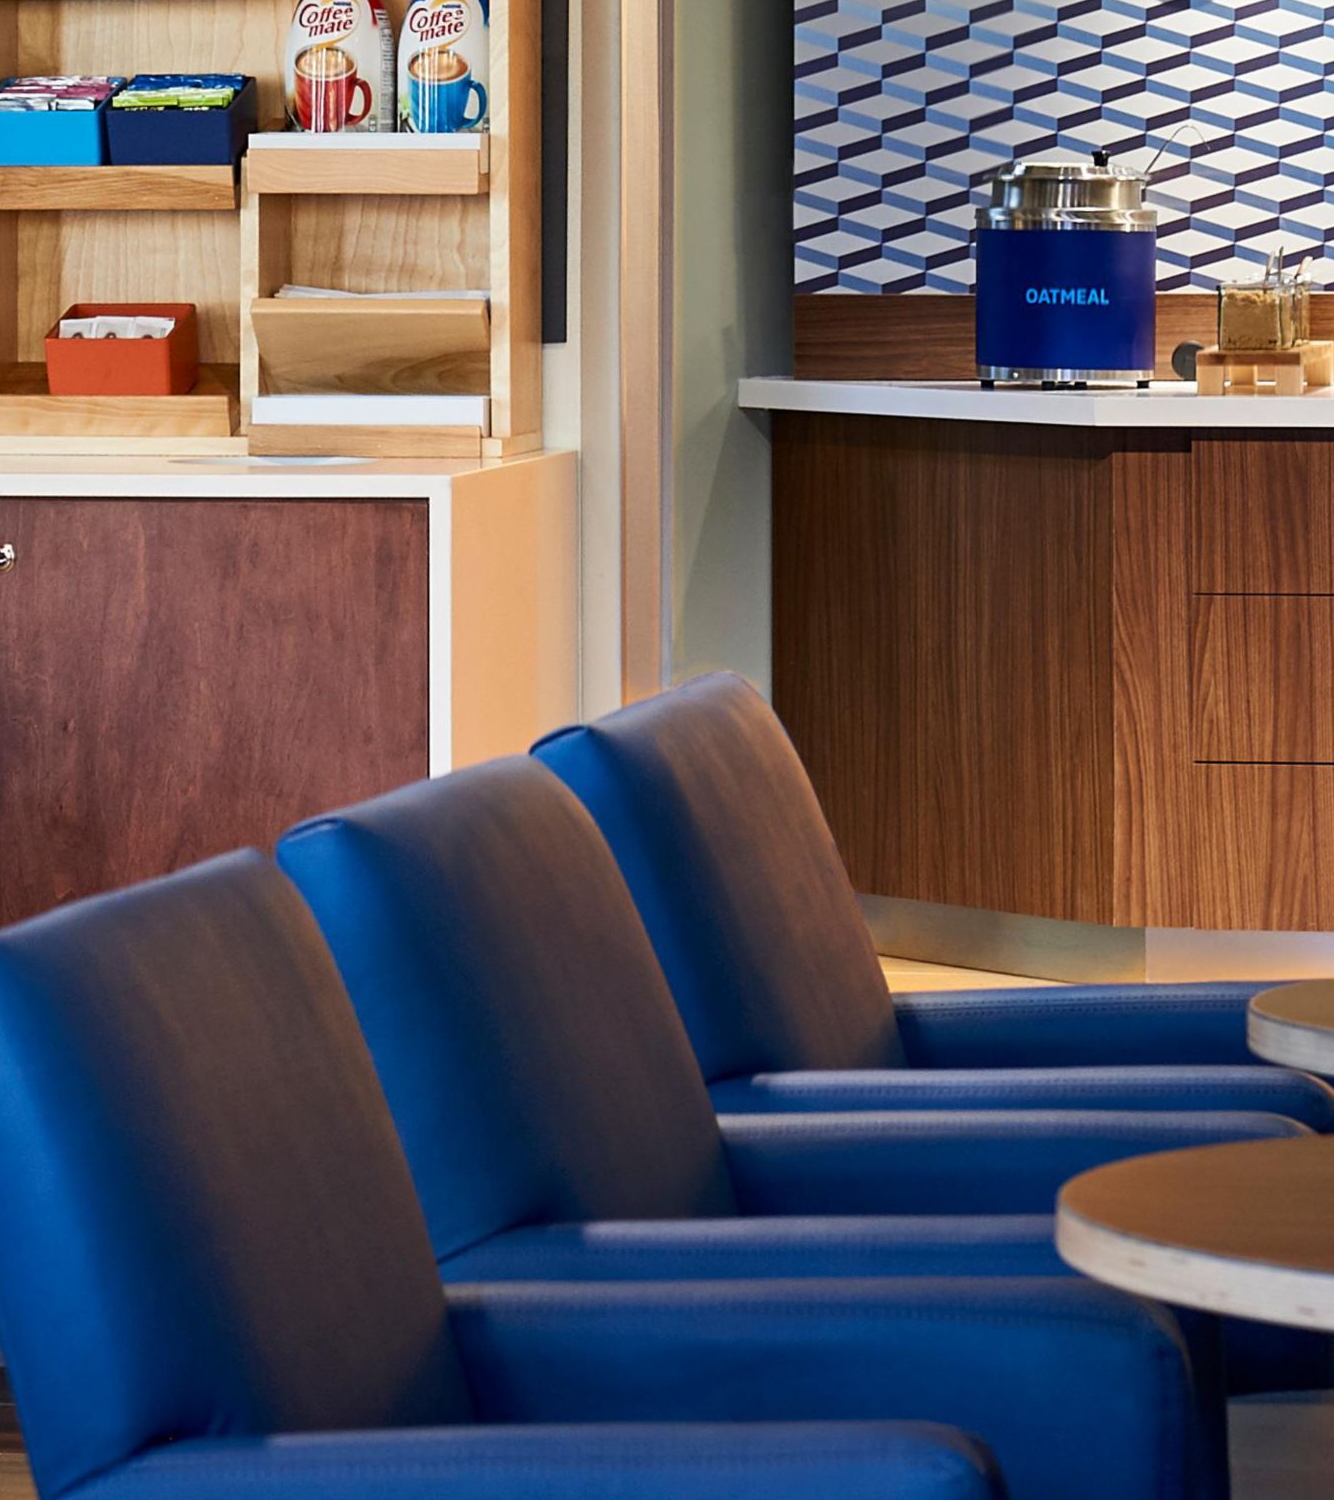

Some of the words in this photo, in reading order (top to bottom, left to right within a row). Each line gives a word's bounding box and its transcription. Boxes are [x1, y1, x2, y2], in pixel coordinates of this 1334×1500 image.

[299, 3, 354, 28] Coffee
[409, 7, 464, 33] Coffee
[308, 19, 354, 37] mate
[420, 21, 465, 42] mate
[1025, 288, 1109, 305] OATMEAL
